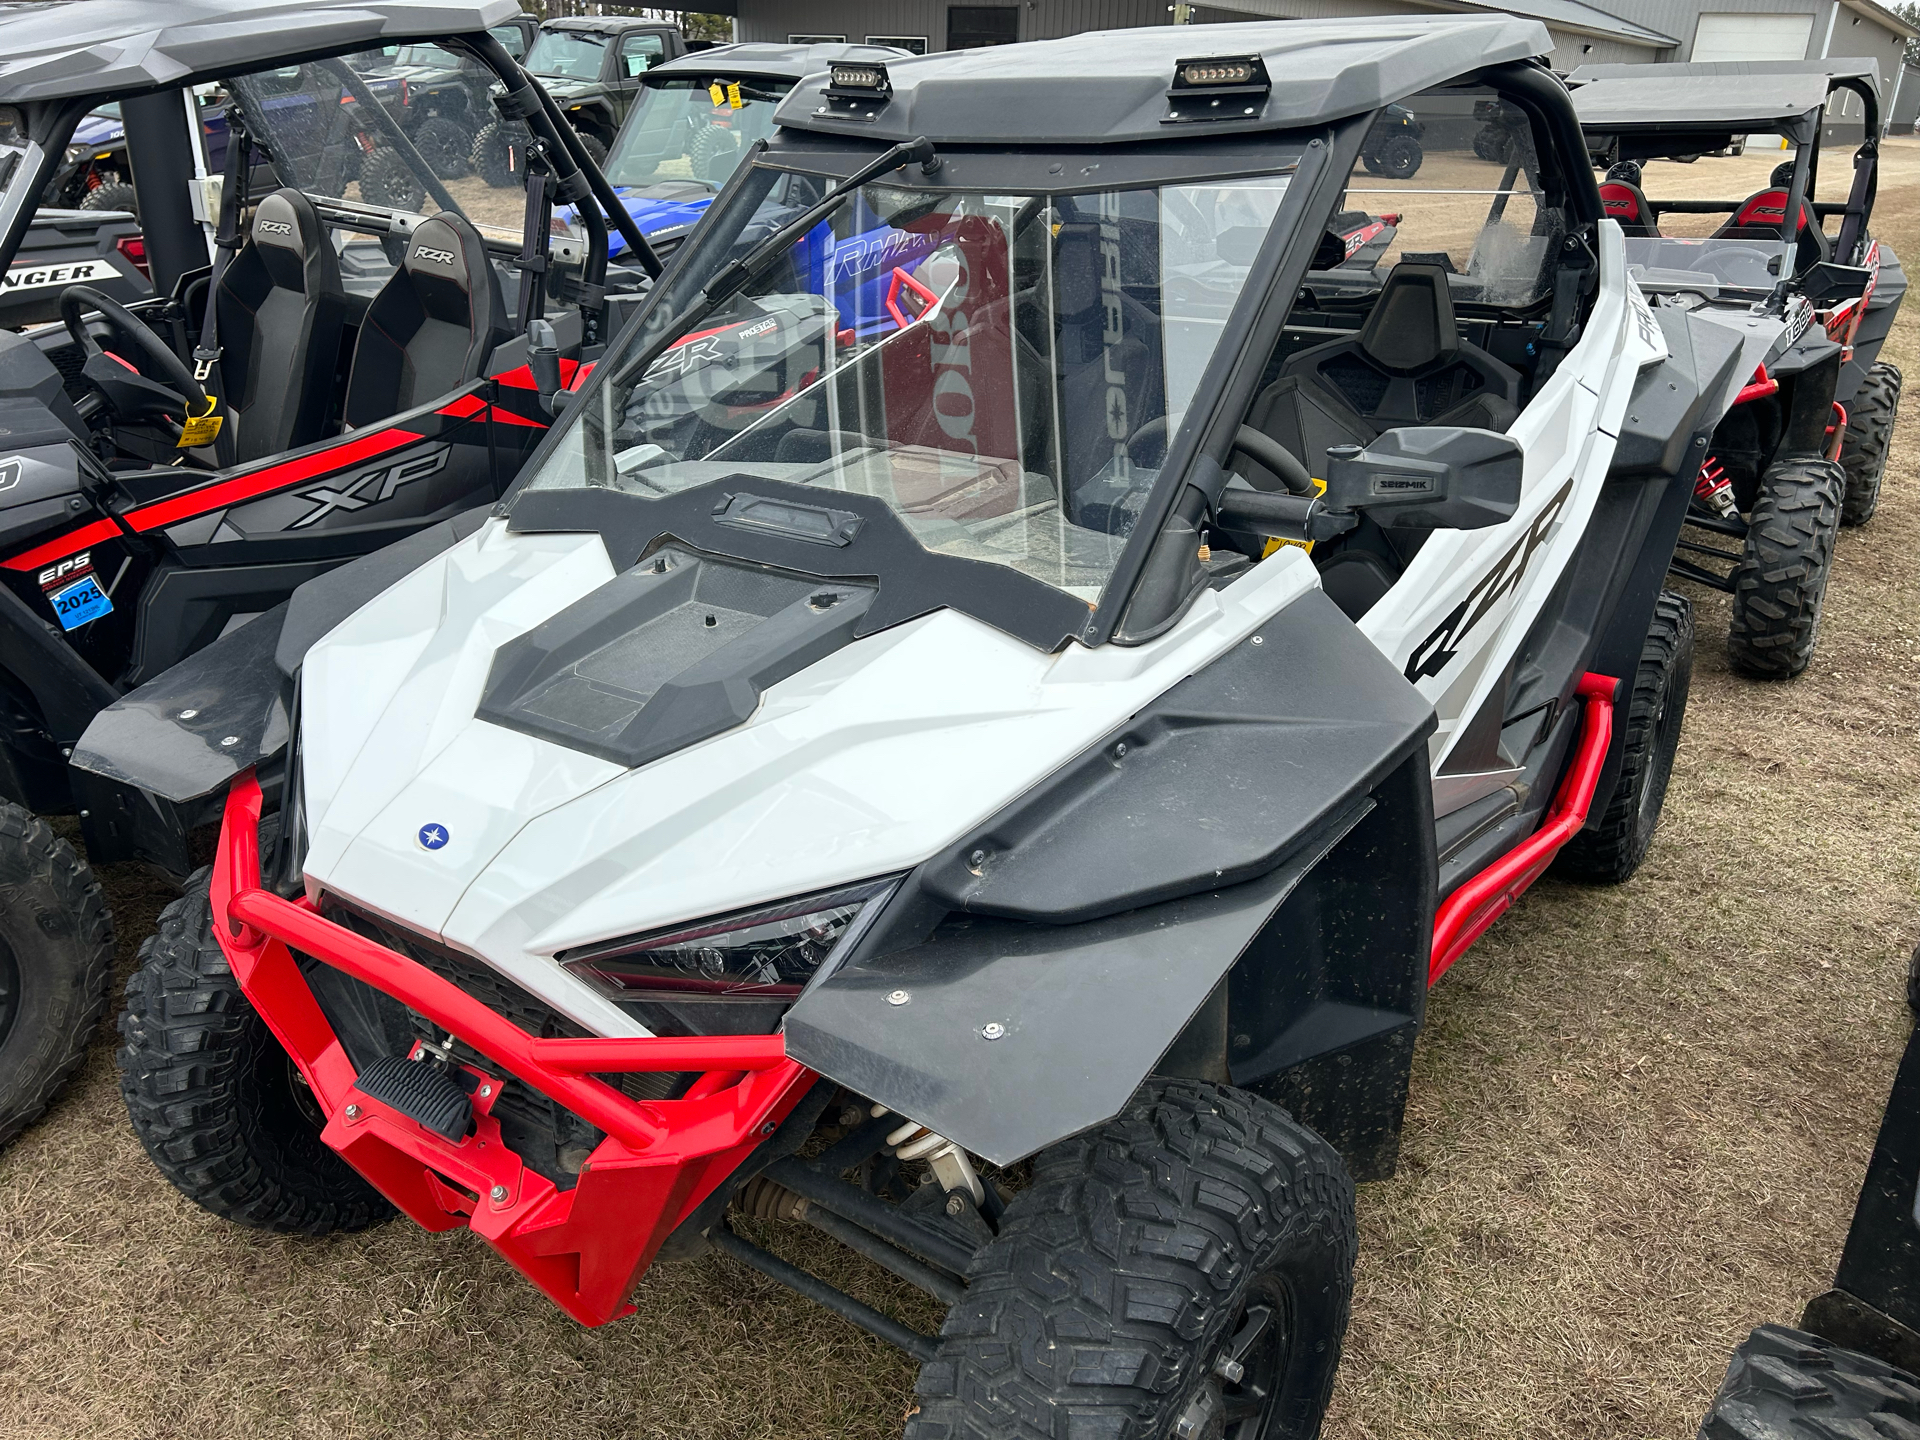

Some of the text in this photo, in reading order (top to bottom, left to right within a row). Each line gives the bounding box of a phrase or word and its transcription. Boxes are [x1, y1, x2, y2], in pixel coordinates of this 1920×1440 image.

[258, 219, 292, 235] RZR
[413, 245, 455, 265] RZR
[280, 443, 453, 531] XP
[1380, 480, 1427, 489] SEIZMIK
[39, 551, 91, 585] EPS
[1404, 477, 1574, 685] RZR
[57, 585, 103, 615] 2025
